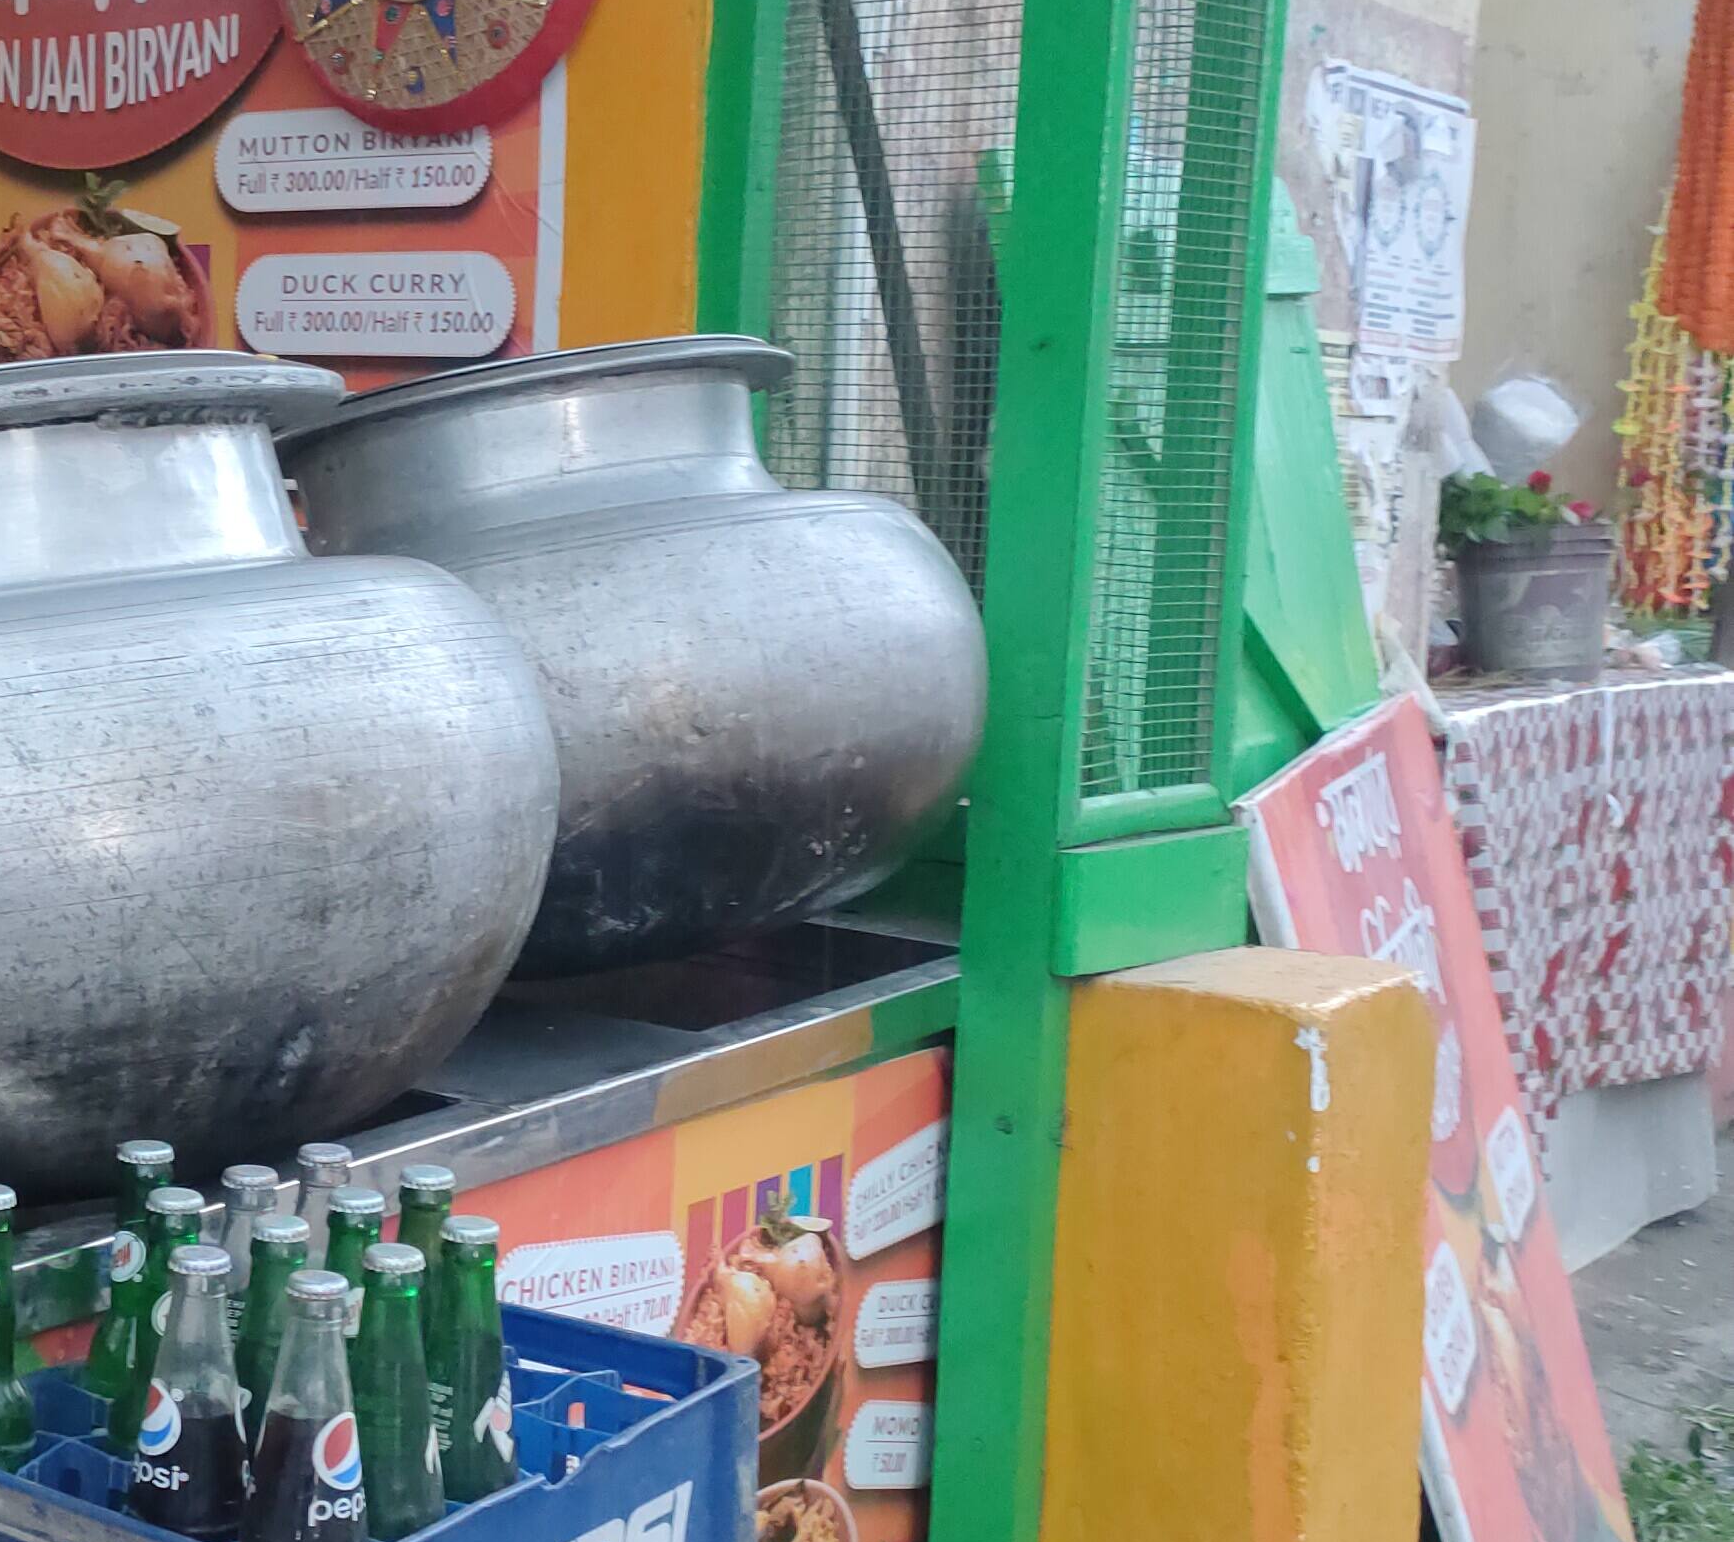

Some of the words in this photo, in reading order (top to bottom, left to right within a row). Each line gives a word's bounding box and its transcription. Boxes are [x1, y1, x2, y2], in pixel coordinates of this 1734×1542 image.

[27, 33, 97, 114] JAAI
[105, 14, 240, 111] BIRYANI
[239, 132, 351, 157] MUTTON
[238, 172, 266, 194] Full
[411, 164, 476, 189] 150.00
[282, 274, 358, 295] DUCK
[370, 273, 467, 295] CURRY
[254, 311, 283, 333] Full
[430, 311, 494, 334] 150.00
[610, 1255, 675, 1289] BIRYANI
[873, 1416, 922, 1436] MOMO
